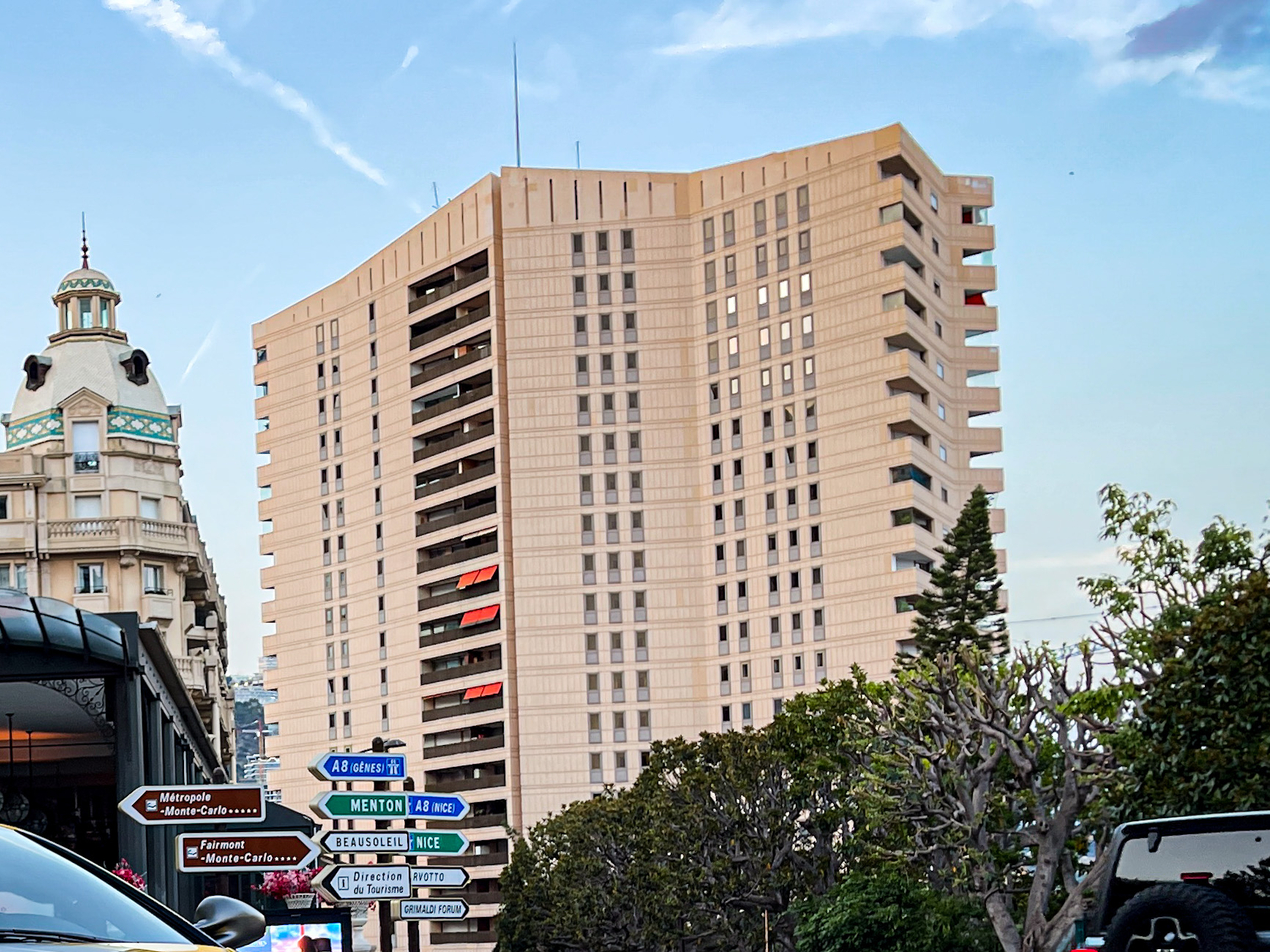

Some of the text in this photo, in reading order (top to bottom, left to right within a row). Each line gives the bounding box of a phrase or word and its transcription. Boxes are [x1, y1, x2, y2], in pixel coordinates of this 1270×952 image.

[332, 759, 385, 774] A8 (GÊNES)
[159, 792, 211, 804] Métropole
[350, 799, 403, 812] MENTON
[415, 800, 455, 814] A8 (NICE)
[200, 839, 245, 850] Fairmont
[336, 836, 403, 847] BEAUSOLEIL
[416, 836, 440, 849] NICE
[353, 871, 403, 882] Direction
[353, 883, 404, 895] du Tourisme
[404, 904, 462, 914] GRIMALDI FORUM
